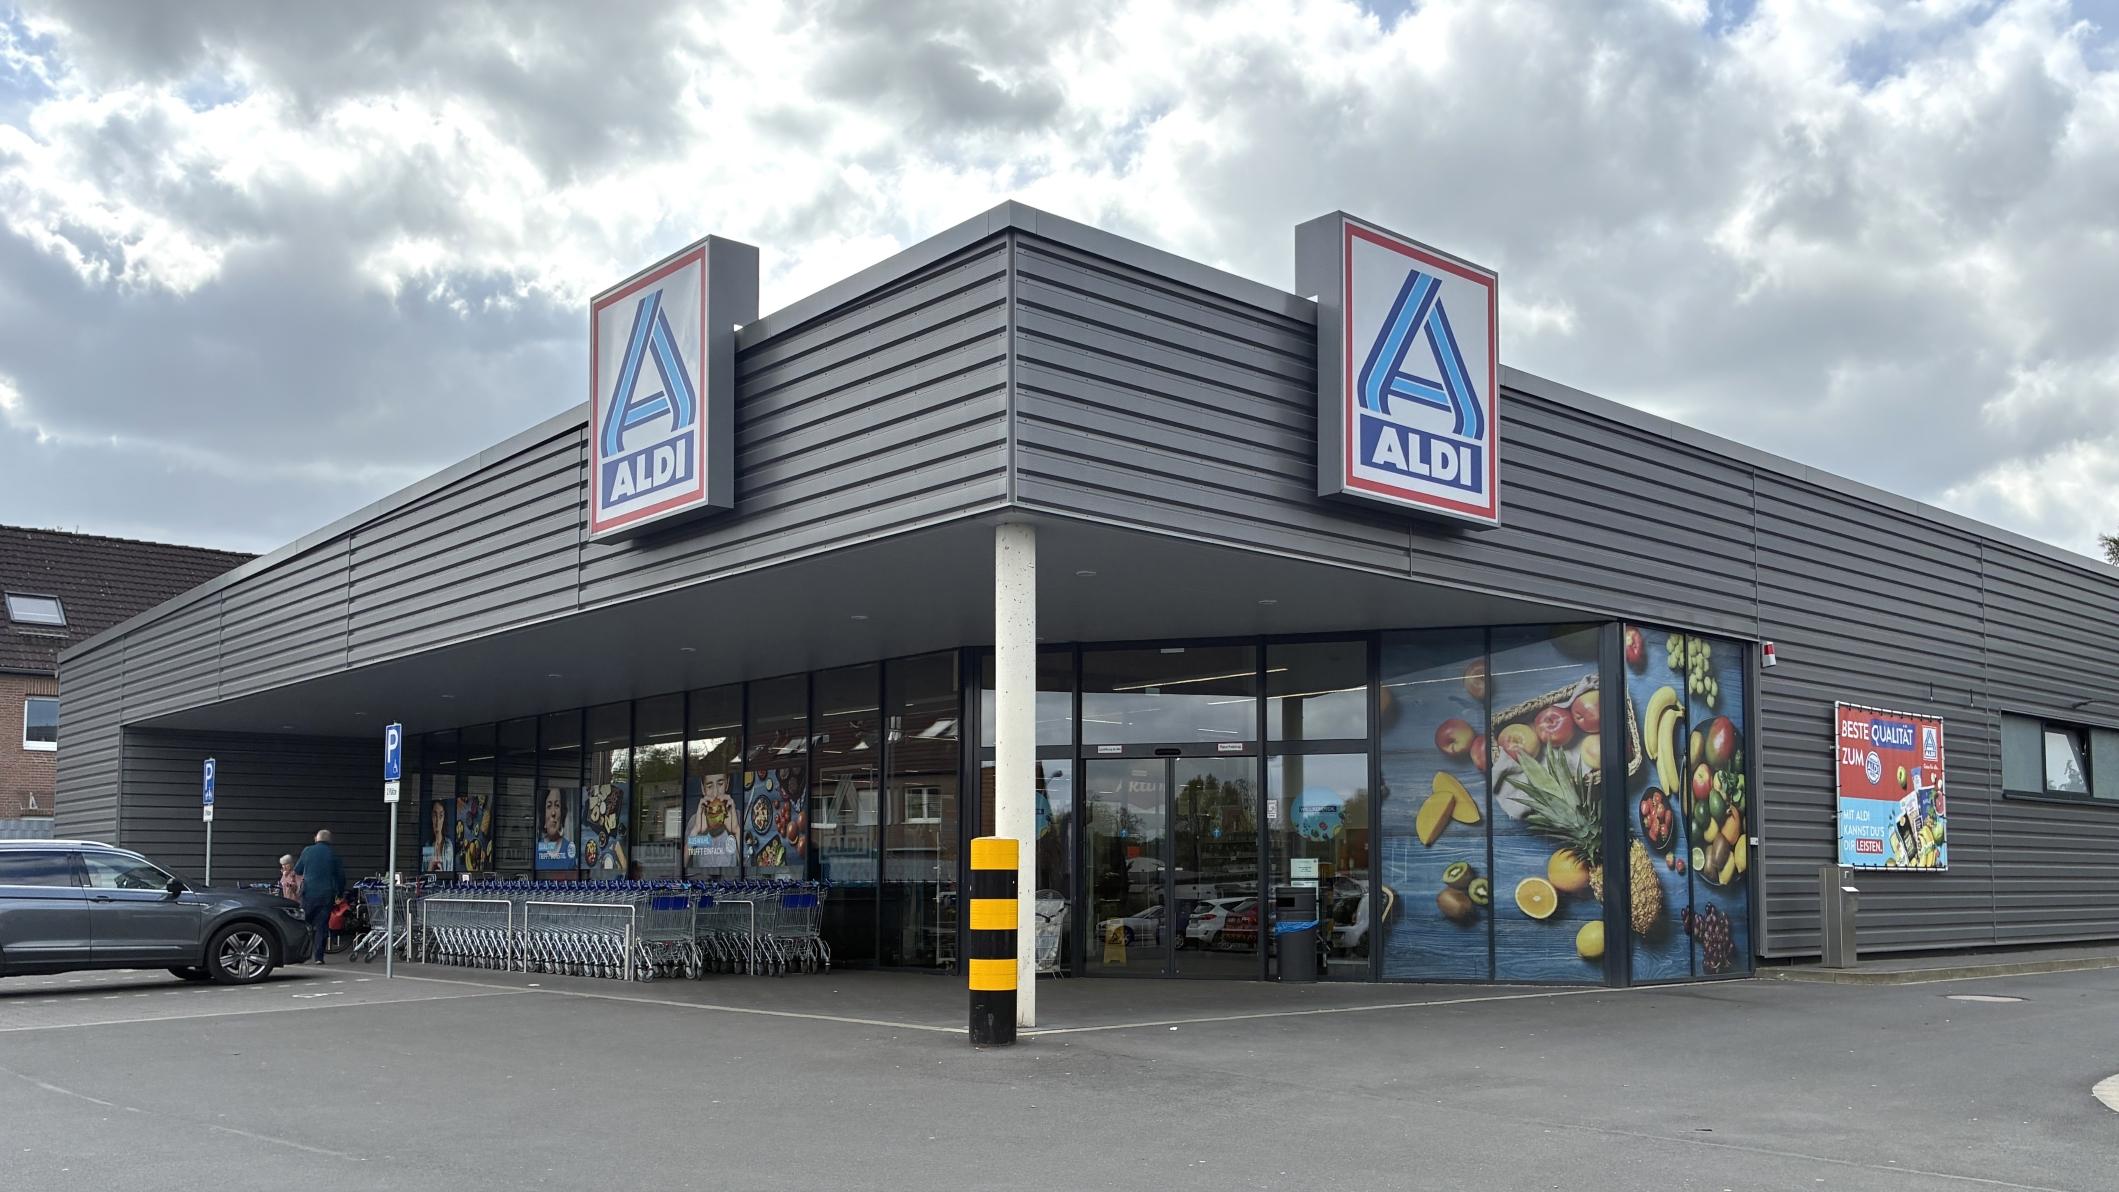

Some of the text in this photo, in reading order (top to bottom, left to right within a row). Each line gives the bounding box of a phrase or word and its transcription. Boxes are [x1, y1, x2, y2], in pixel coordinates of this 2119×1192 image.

[1371, 425, 1472, 487] ALDI
[609, 438, 686, 503] ALDI
[387, 729, 398, 763] P
[1841, 720, 1914, 746] BESTE QUALITÄT
[1842, 747, 1864, 766] ZUM
[205, 763, 213, 790] P
[1856, 809, 1870, 821] ALDI
[1843, 824, 1869, 836] KANNST
[1844, 839, 1883, 852] DIR LEISTEN.
